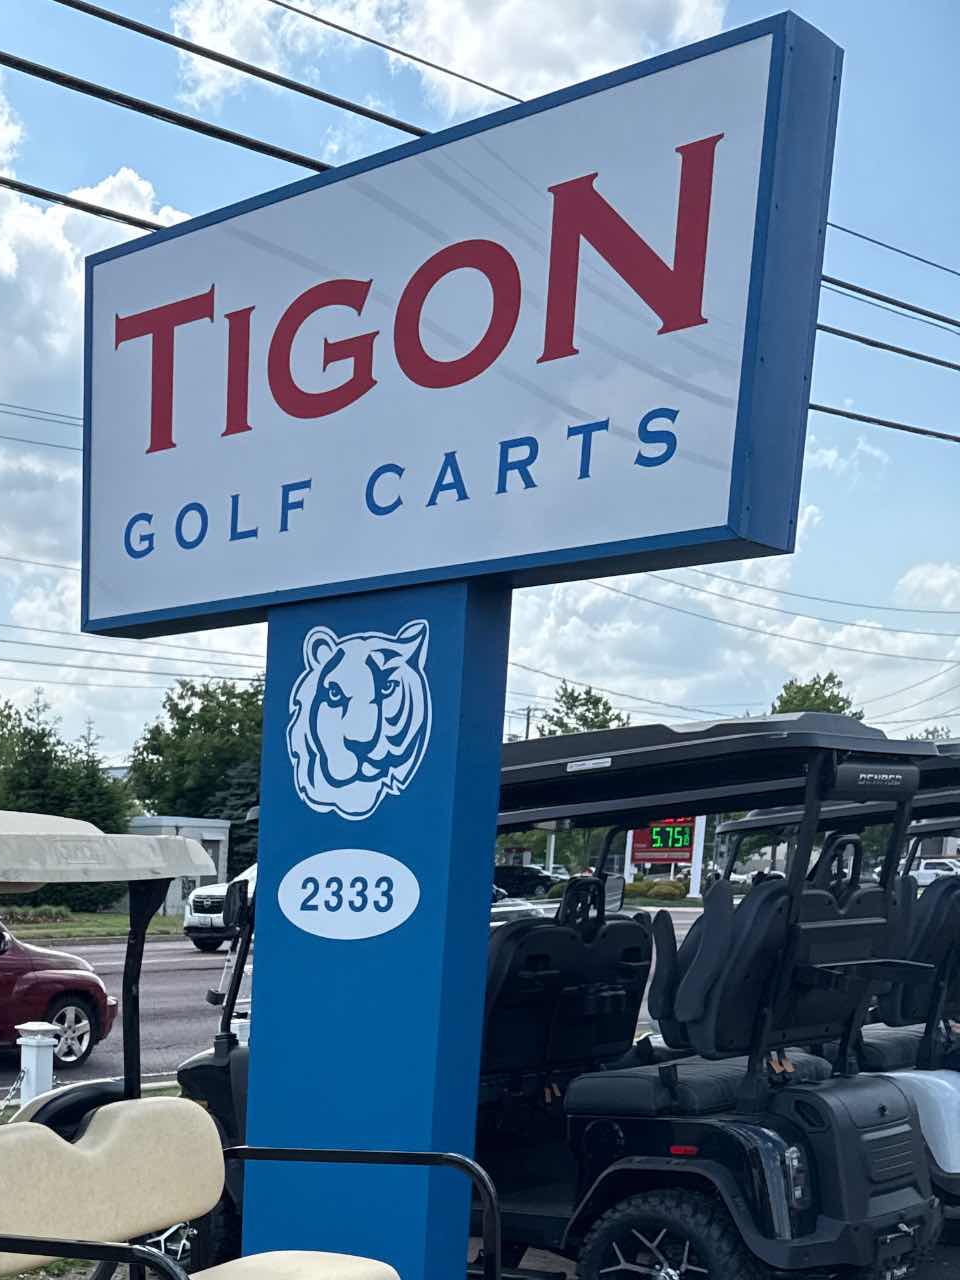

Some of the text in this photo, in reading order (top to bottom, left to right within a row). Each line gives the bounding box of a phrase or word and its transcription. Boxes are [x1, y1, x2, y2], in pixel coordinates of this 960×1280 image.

[115, 133, 724, 454] TIGON
[123, 407, 679, 560] GOLF CARTS
[300, 876, 394, 912] 2333
